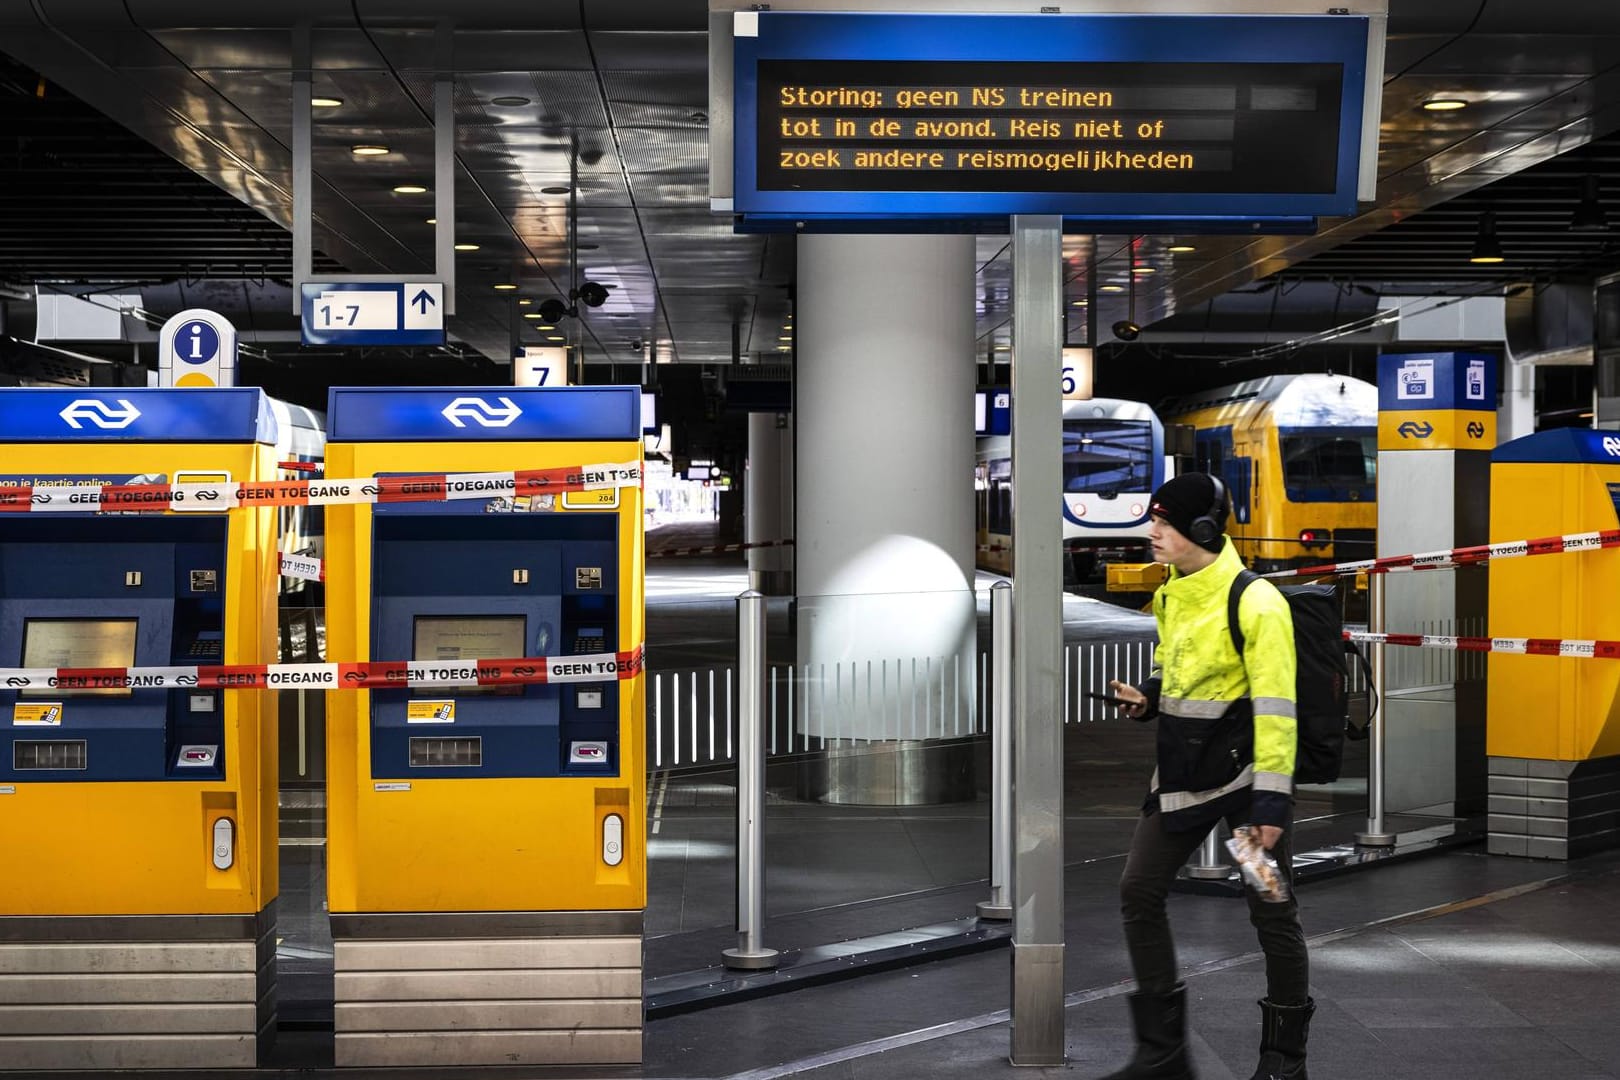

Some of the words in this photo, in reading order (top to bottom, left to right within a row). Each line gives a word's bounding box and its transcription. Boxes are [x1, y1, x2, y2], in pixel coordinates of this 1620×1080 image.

[781, 87, 882, 108] Storing:
[896, 90, 959, 108] geen
[972, 88, 1005, 106] NS
[1020, 88, 1112, 106] treinen
[781, 118, 821, 136] tot
[836, 118, 856, 136] in
[869, 118, 901, 136] de
[915, 119, 996, 137] avond.
[1010, 119, 1061, 137] Reis
[1075, 120, 1123, 138] niet
[1138, 120, 1164, 138] of
[780, 149, 841, 167] zoek
[855, 149, 944, 167] andere
[958, 150, 1193, 171] reismogelijkheden
[320, 305, 360, 326] 1-7
[532, 367, 550, 386] 7
[1062, 367, 1076, 395] 6
[567, 471, 605, 484] GEEN
[235, 488, 275, 500] GEEN
[280, 486, 350, 498] TOEGANG
[402, 483, 441, 494] GEEN
[446, 480, 516, 492] TOEGANG
[69, 493, 109, 503] GEEN
[115, 491, 185, 503] TOEGANG
[1562, 540, 1583, 548] GEEN
[385, 669, 425, 681] GEEN
[430, 667, 501, 680] TOEGANG
[552, 663, 592, 676] GEEN
[47, 677, 87, 687] GEEN
[94, 675, 164, 687] TOEGANG
[216, 673, 256, 685] GEEN
[261, 672, 333, 684] TOEGANG
